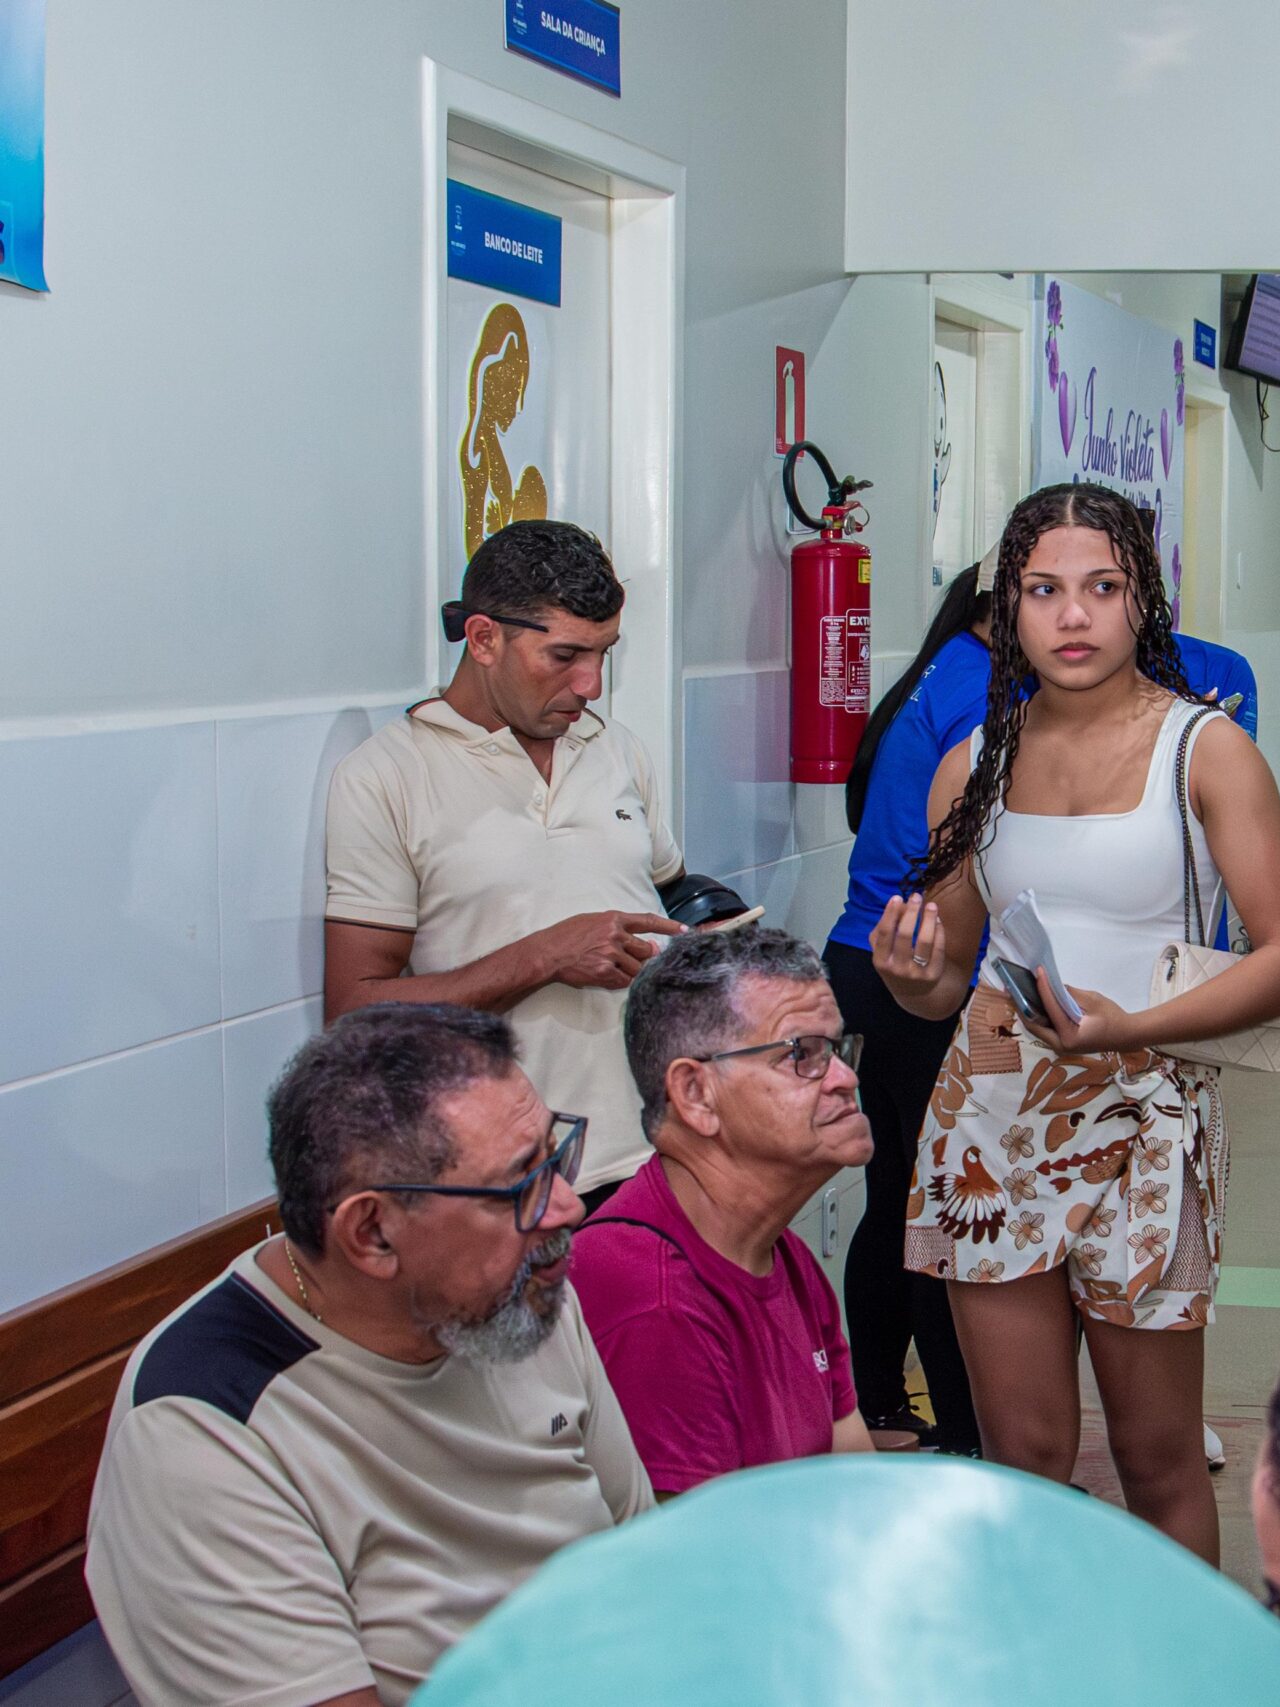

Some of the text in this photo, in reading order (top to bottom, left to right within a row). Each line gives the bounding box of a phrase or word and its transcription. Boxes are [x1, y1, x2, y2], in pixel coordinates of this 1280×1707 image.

[541, 11, 561, 34] SALA
[562, 21, 573, 40] DA
[574, 27, 606, 56] CRIANÇA
[484, 231, 511, 254] BANCO
[512, 240, 522, 258] DE
[523, 244, 543, 264] LEITE
[1082, 366, 1154, 483] Junho Violeta
